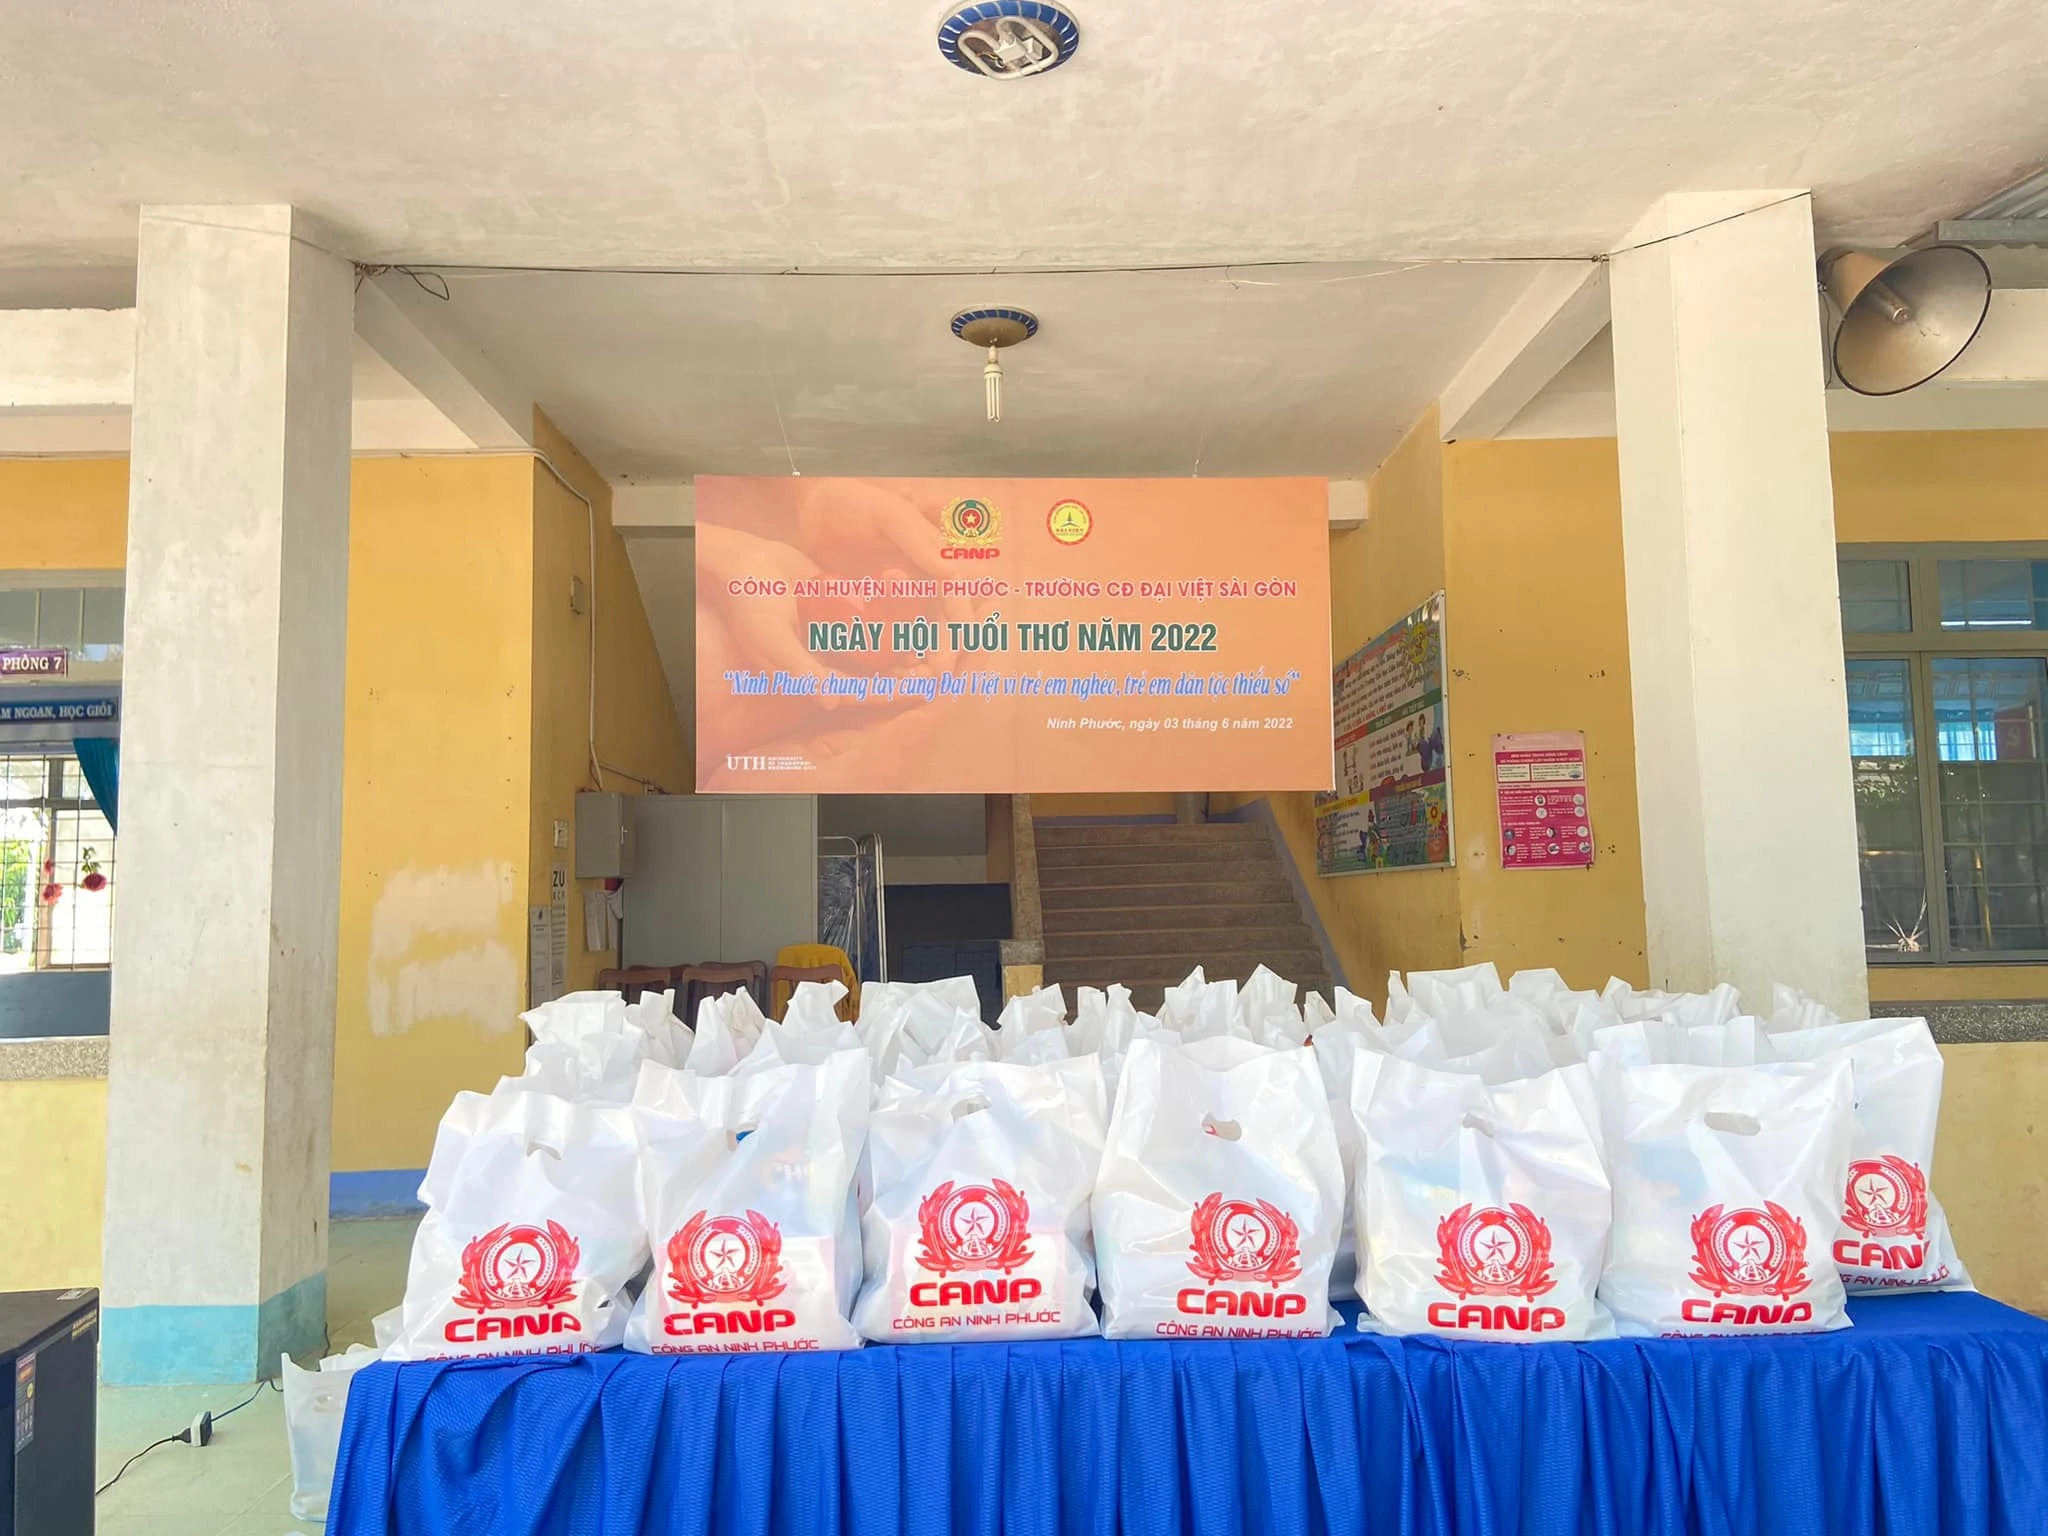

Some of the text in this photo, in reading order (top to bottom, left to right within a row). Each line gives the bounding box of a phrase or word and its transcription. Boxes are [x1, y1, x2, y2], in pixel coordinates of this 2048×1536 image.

[940, 547, 1000, 560] CANP
[728, 575, 787, 596] CÔNG
[793, 580, 819, 596] AN
[826, 576, 885, 601] HUYỆN
[891, 581, 937, 597] NINH
[943, 576, 1009, 597] PHƯỚC
[1025, 577, 1101, 597] TRƯỜNG
[1106, 581, 1134, 597] CĐ
[1140, 581, 1172, 601] ĐẠI
[1178, 577, 1214, 601] VIỆT
[1219, 576, 1248, 597] SÀI
[1254, 576, 1296, 597] GÒN
[809, 611, 1217, 657] NGÀY HỘI TUỔI THƠ NĂM 2022
[53, 656, 62, 670] 7
[821, 671, 868, 701] chung
[871, 672, 897, 700] tay
[940, 672, 968, 701] Đại
[970, 671, 1001, 702] Việt
[1044, 678, 1068, 695] em
[1148, 677, 1172, 695] em
[14, 705, 57, 720] NGOAN,
[60, 705, 84, 720] HỌC
[1046, 717, 1076, 729] Ninh
[1129, 717, 1160, 732] ngày
[1163, 717, 1179, 729] 03
[1182, 717, 1218, 732] tháng
[1221, 717, 1230, 729] 6
[1263, 717, 1293, 729] 2022
[727, 755, 767, 771] UTH
[910, 1278, 1042, 1307] CANP
[1177, 1288, 1307, 1318] CANP
[663, 1309, 796, 1336] CANP
[893, 1315, 935, 1330] CÔNG
[940, 1316, 962, 1328] AN
[966, 1314, 1000, 1326] NINH
[1428, 1302, 1566, 1332] CANP
[1681, 1298, 1812, 1325] CANP
[444, 1311, 582, 1342] CANP
[1156, 1320, 1198, 1337] CÔNG
[1202, 1325, 1225, 1338] AN
[1228, 1327, 1262, 1338] NINH
[651, 1342, 694, 1354] CÔNG
[697, 1344, 719, 1354] AN
[723, 1341, 759, 1353] NINH
